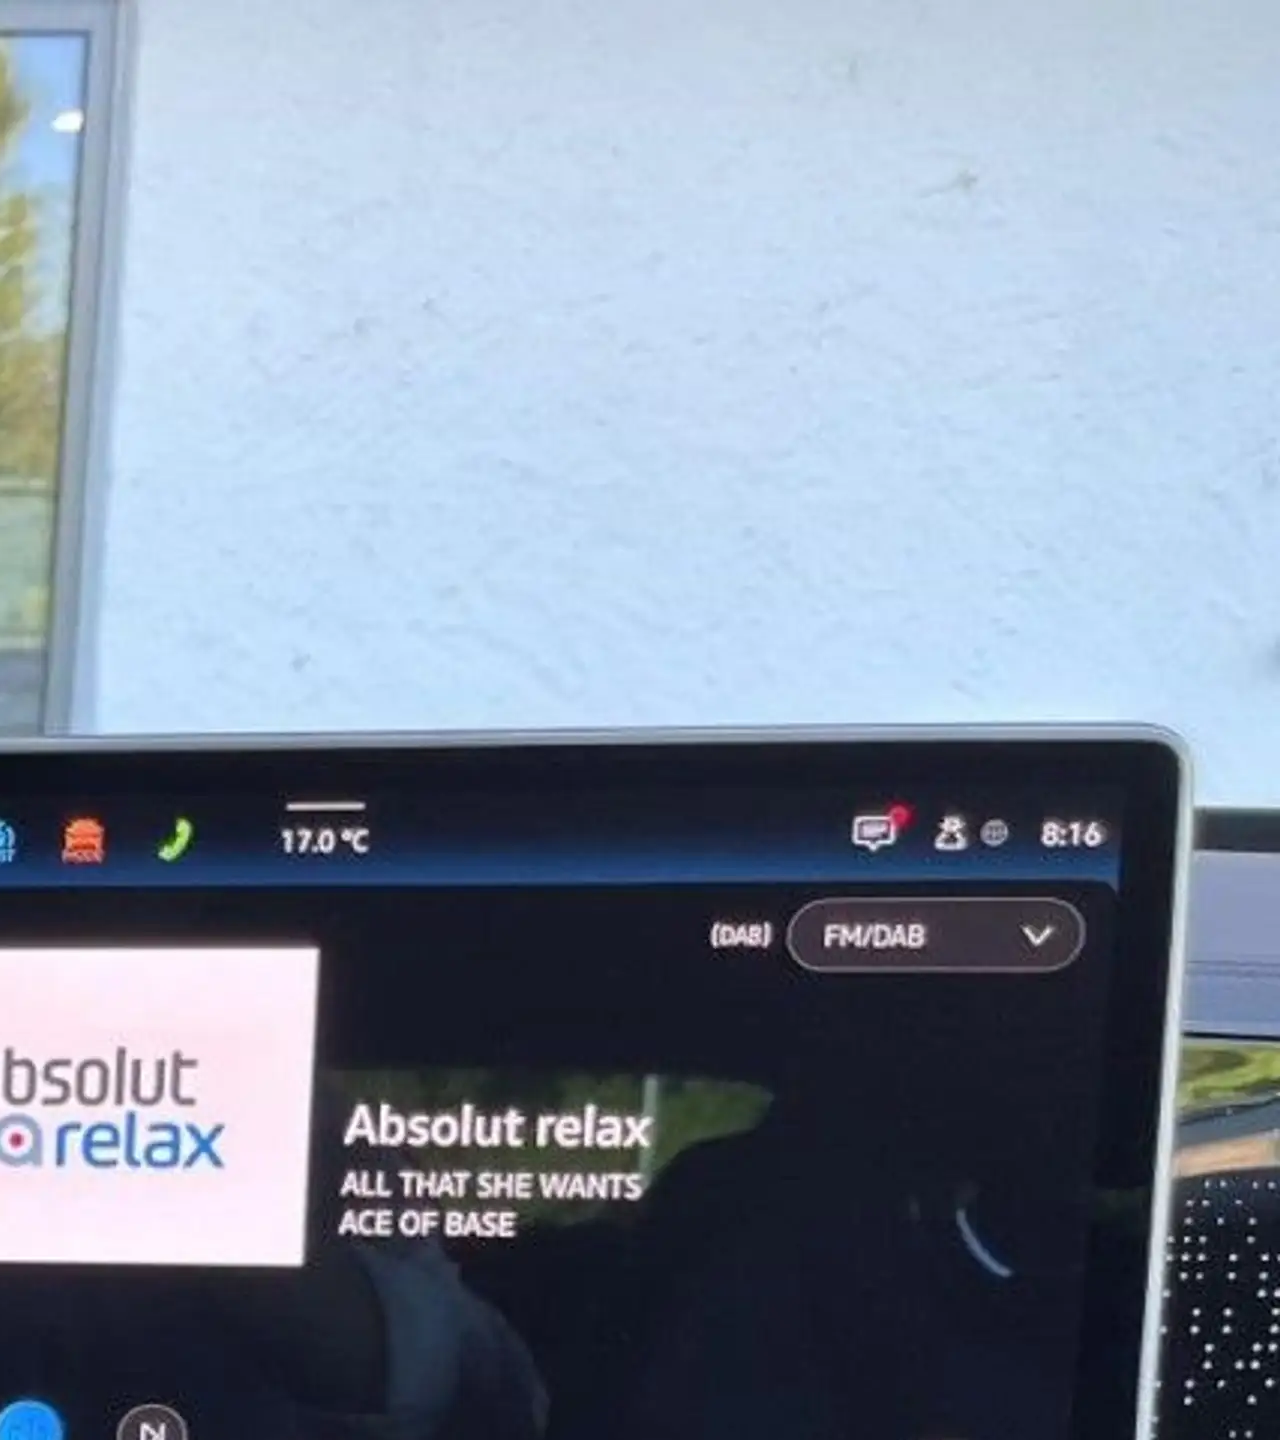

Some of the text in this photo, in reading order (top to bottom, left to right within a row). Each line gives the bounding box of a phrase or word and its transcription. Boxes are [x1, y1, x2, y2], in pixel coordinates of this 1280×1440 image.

[281, 829, 333, 854] 17.0
[1041, 821, 1105, 848] 8:16
[823, 923, 928, 949] FM/DAB
[343, 1103, 654, 1149] Absolut relax
[340, 1171, 644, 1201] ALL THAT SHE WANTS
[338, 1209, 518, 1238] ACE OF BASE
